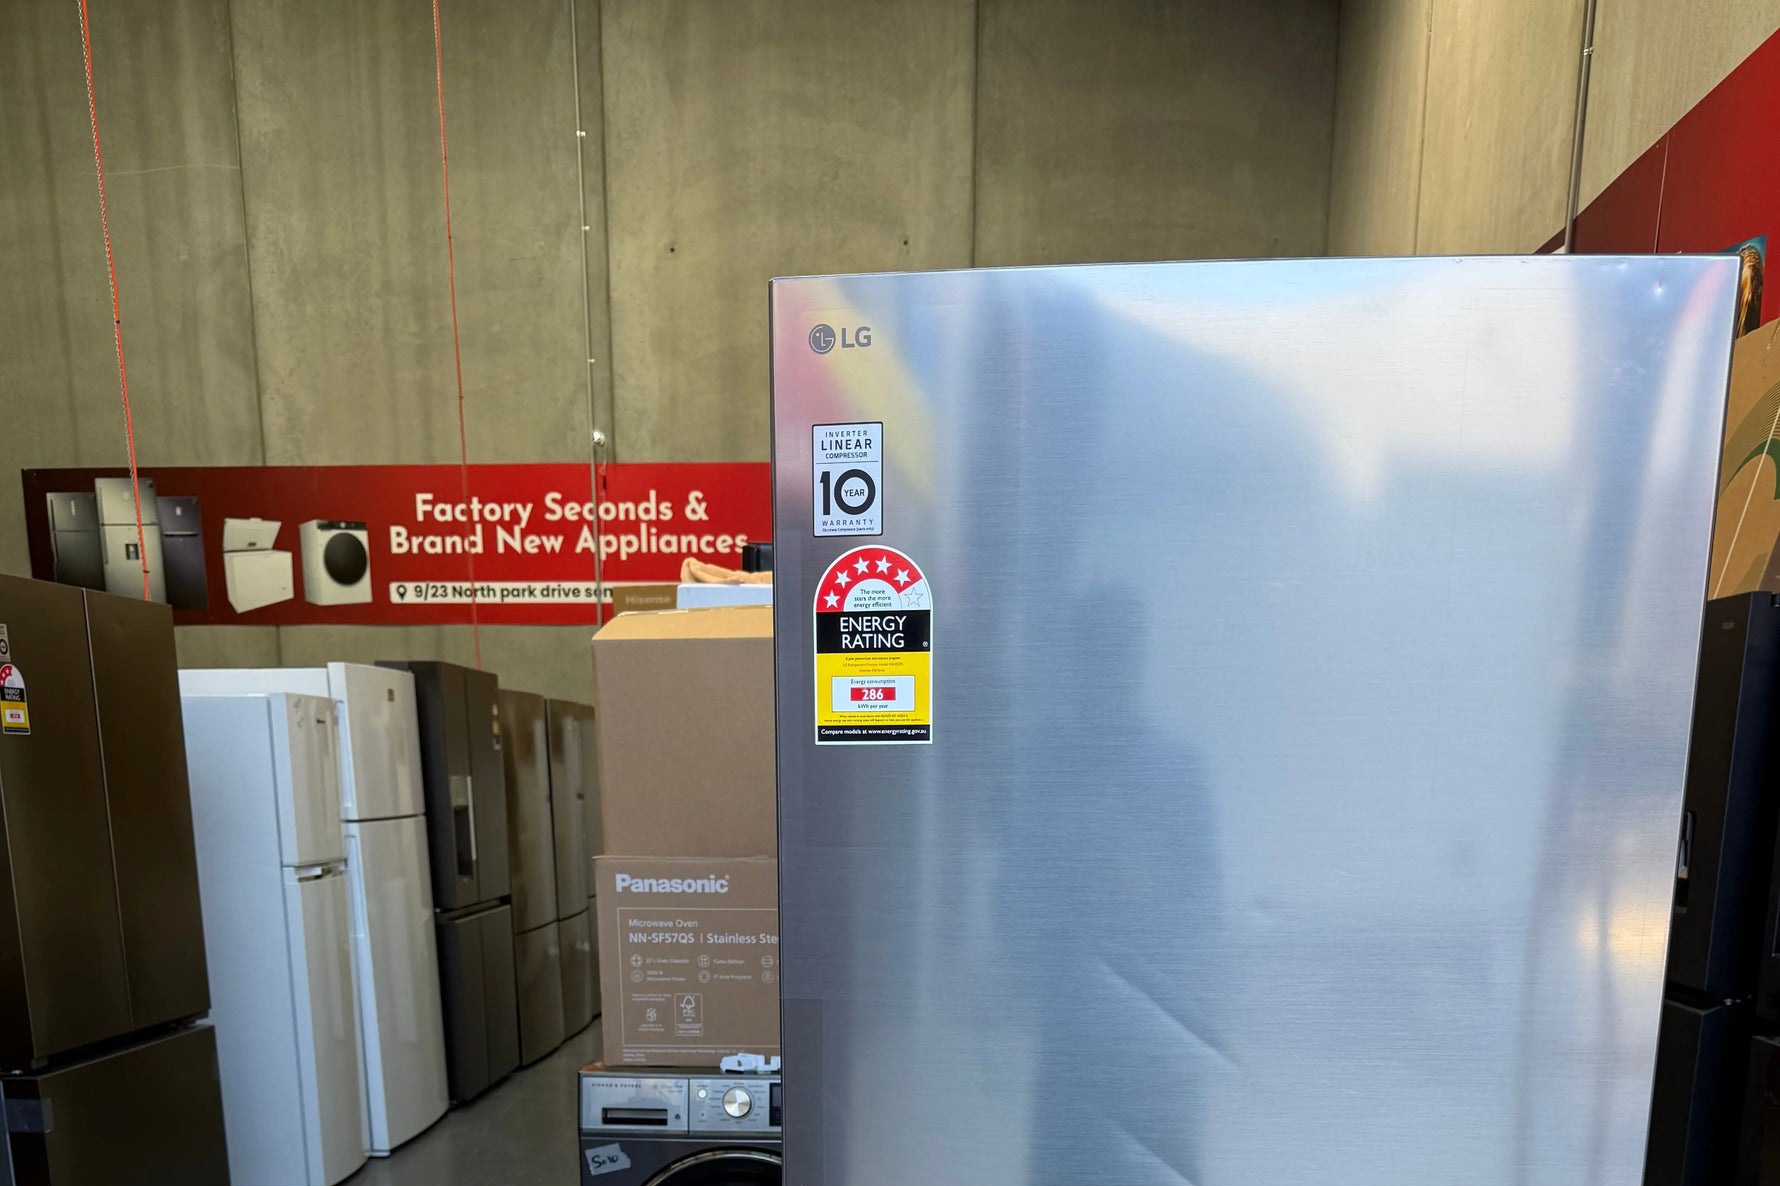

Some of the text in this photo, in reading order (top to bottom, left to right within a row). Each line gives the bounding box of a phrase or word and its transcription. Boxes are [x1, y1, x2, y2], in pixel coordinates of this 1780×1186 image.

[841, 326, 871, 348] LG
[826, 430, 868, 438] INVERTER
[821, 439, 872, 450] LINEAR
[820, 469, 876, 515] 10
[844, 489, 865, 497] YEAR
[415, 489, 709, 528] Factory Seconds &
[389, 522, 748, 561] Brand New Appliances
[414, 583, 448, 601] 9/23
[452, 585, 496, 598] North
[500, 585, 536, 602] park
[541, 584, 580, 598] drive
[840, 616, 906, 632] ENERGY
[842, 633, 905, 649] RATING
[862, 689, 883, 700] 286
[615, 874, 728, 893] Panasonic
[628, 919, 698, 928] Microwave Oven
[629, 933, 778, 944] NN-SF57QS Stainless Ste
